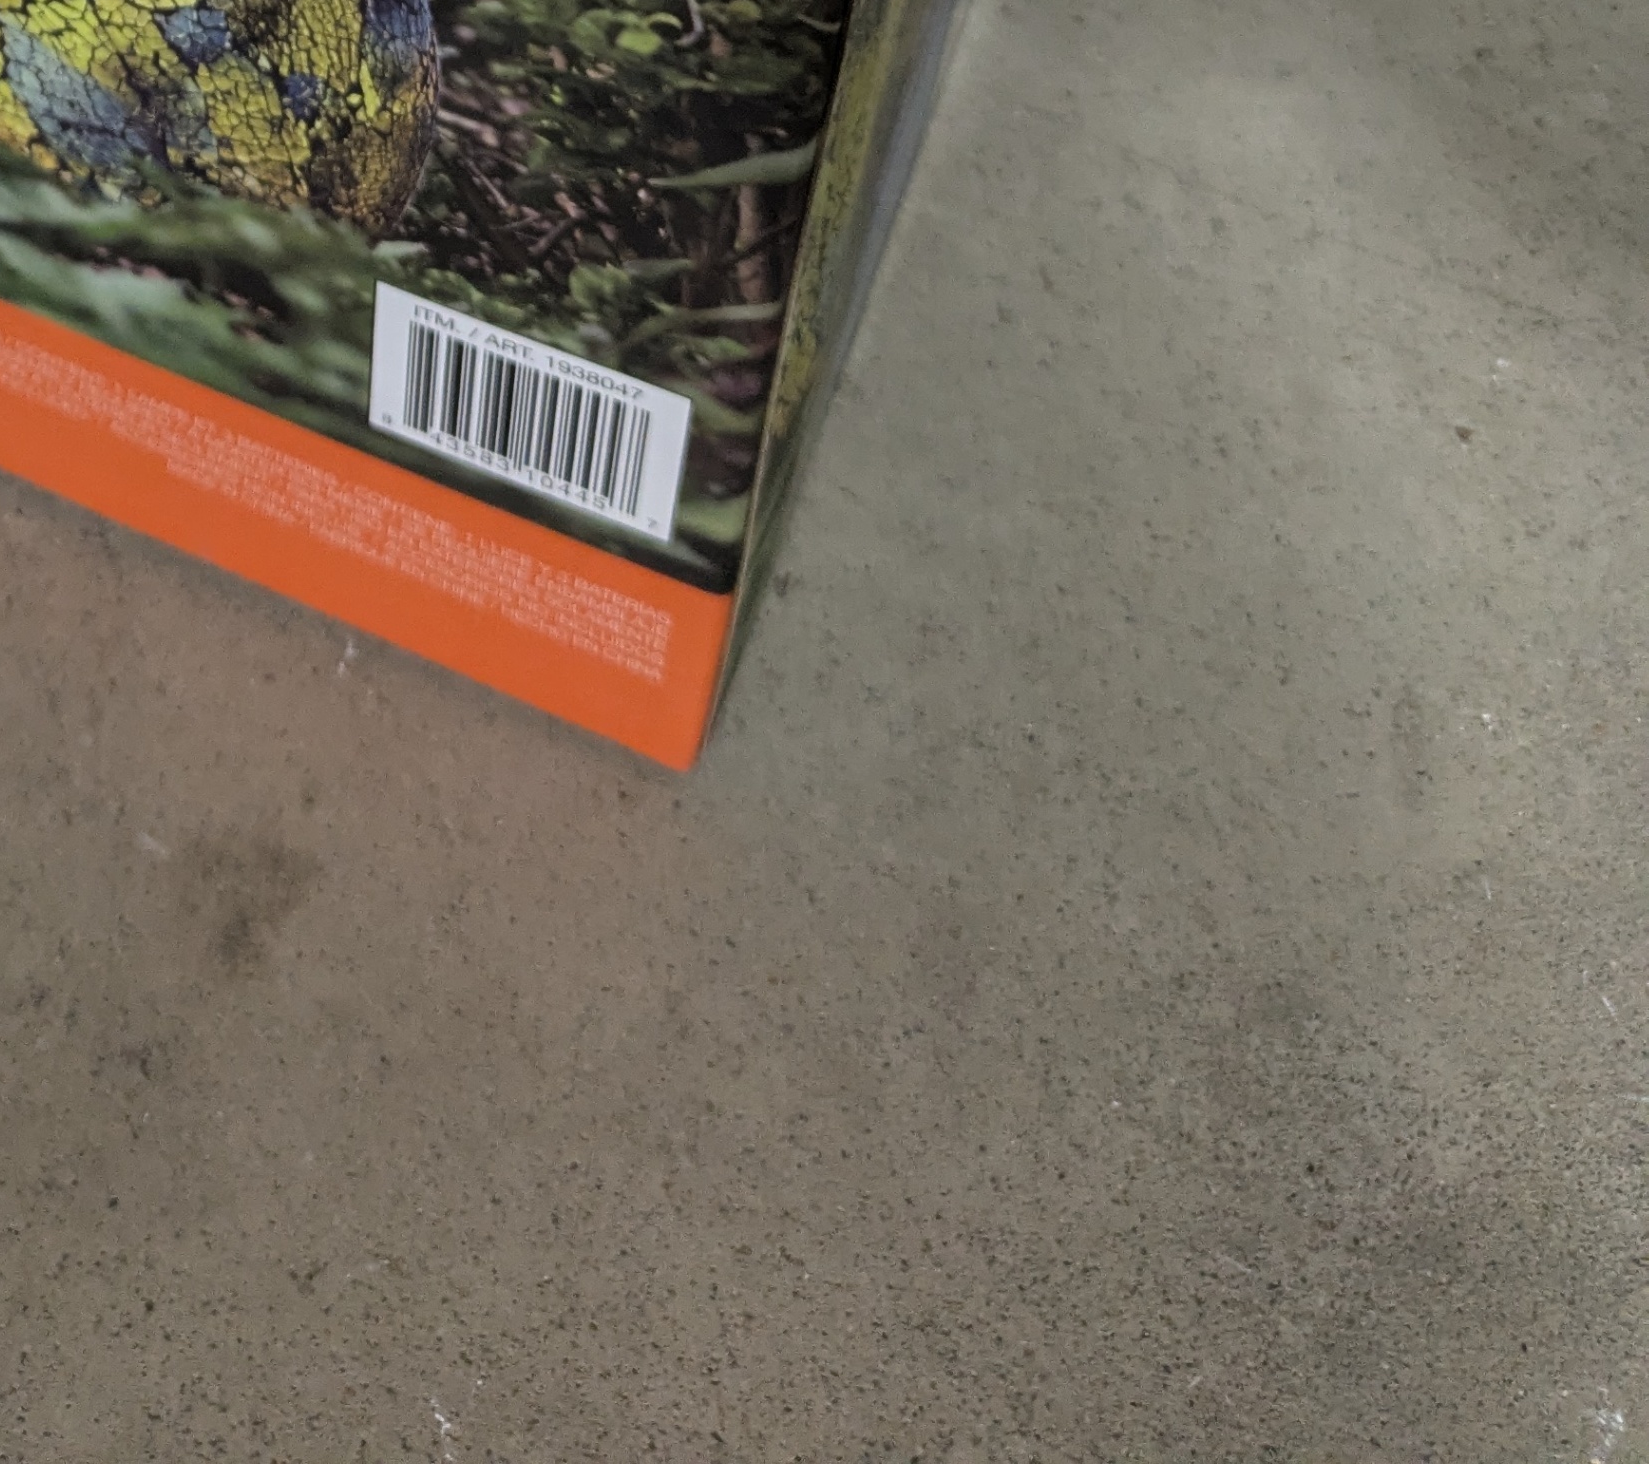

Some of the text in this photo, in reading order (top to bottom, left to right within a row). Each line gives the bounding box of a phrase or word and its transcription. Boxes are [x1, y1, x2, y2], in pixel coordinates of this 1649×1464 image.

[413, 304, 461, 337] ITM.
[484, 331, 535, 363] ART.
[545, 354, 644, 401] 1938047
